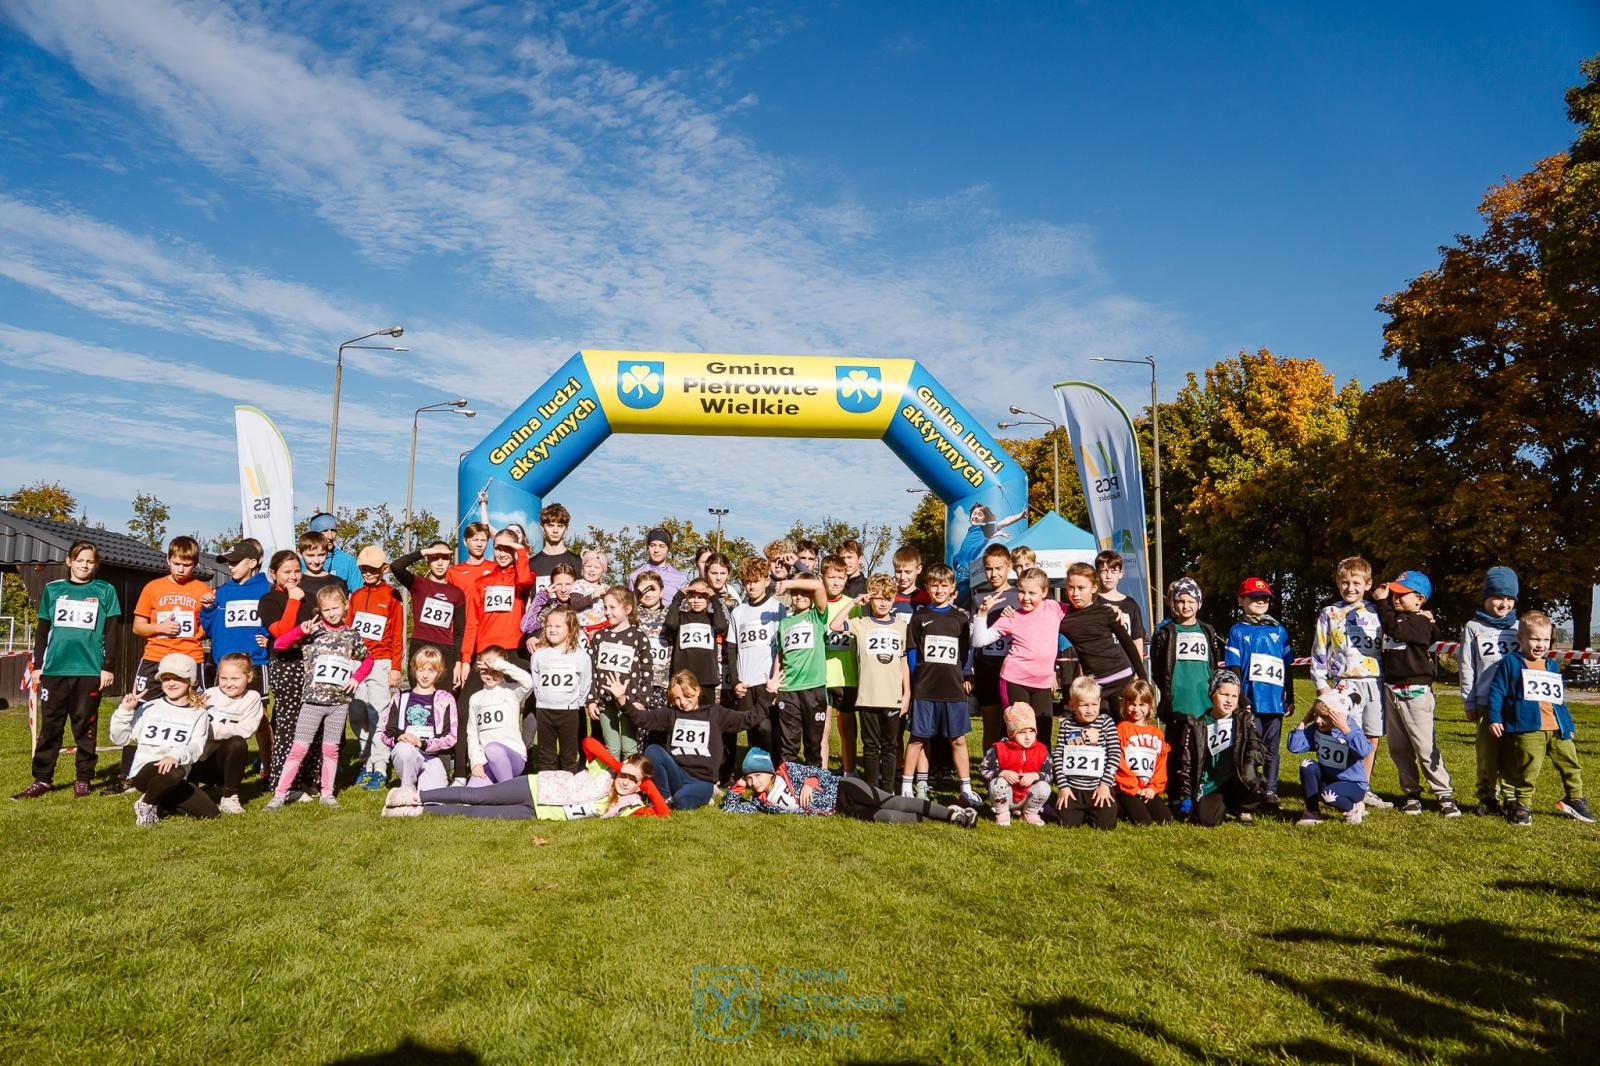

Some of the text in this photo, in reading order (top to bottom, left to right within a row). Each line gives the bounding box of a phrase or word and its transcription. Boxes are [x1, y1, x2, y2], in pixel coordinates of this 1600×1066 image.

[706, 362, 795, 376] Gmina
[683, 377, 819, 396] Pietrowice
[699, 397, 800, 416] Wielkie
[489, 376, 583, 465] Gmina ludzi
[917, 386, 1004, 474] Gmina ludzi
[508, 398, 598, 480] aktywnych
[901, 404, 985, 488] aktywnych
[486, 594, 513, 607] 294
[227, 609, 259, 622] 320
[423, 606, 452, 623] 287
[354, 620, 382, 636] 282
[740, 629, 768, 643] 288
[784, 632, 811, 647] 237
[869, 637, 900, 650] 255
[1351, 635, 1383, 650] 239
[926, 645, 956, 659] 279
[1178, 642, 1206, 655] 249
[1482, 641, 1521, 656] 232
[599, 651, 631, 668] 242
[316, 664, 349, 681] 277
[541, 673, 573, 686] 202
[1252, 663, 1283, 681] 244
[1527, 680, 1562, 699] 233
[476, 710, 504, 726] 280
[145, 725, 188, 743] 315
[674, 729, 706, 744] 281
[1209, 728, 1232, 749] 22
[1066, 756, 1100, 771] 321
